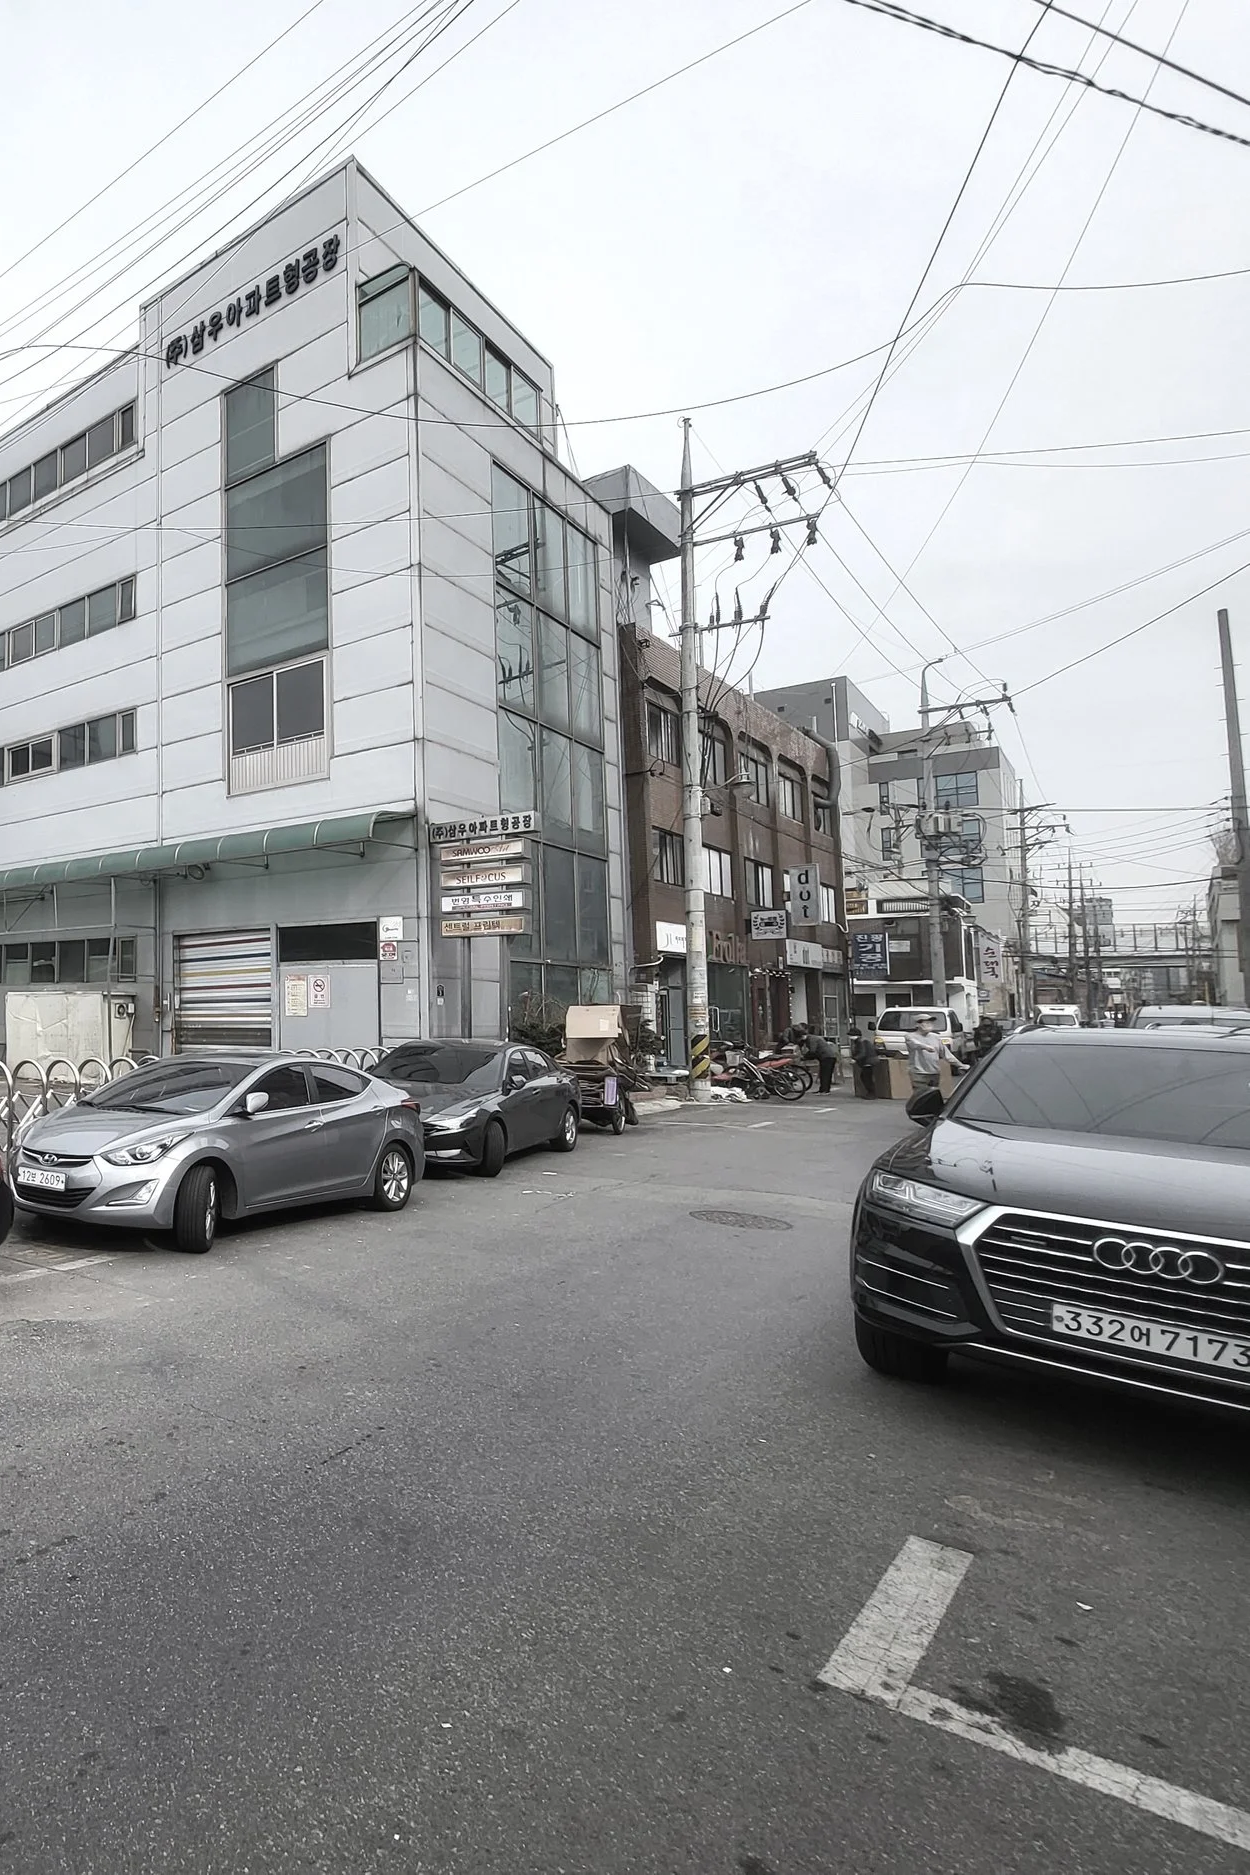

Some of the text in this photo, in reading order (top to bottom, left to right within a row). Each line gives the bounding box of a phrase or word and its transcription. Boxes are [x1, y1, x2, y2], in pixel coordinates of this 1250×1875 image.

[166, 234, 340, 369] (주)삼우아파트형공장
[432, 814, 532, 839] (주)삼우아파트형공장
[39, 1172, 61, 1186] 2609
[1064, 1309, 1250, 1368] 332어 7173
